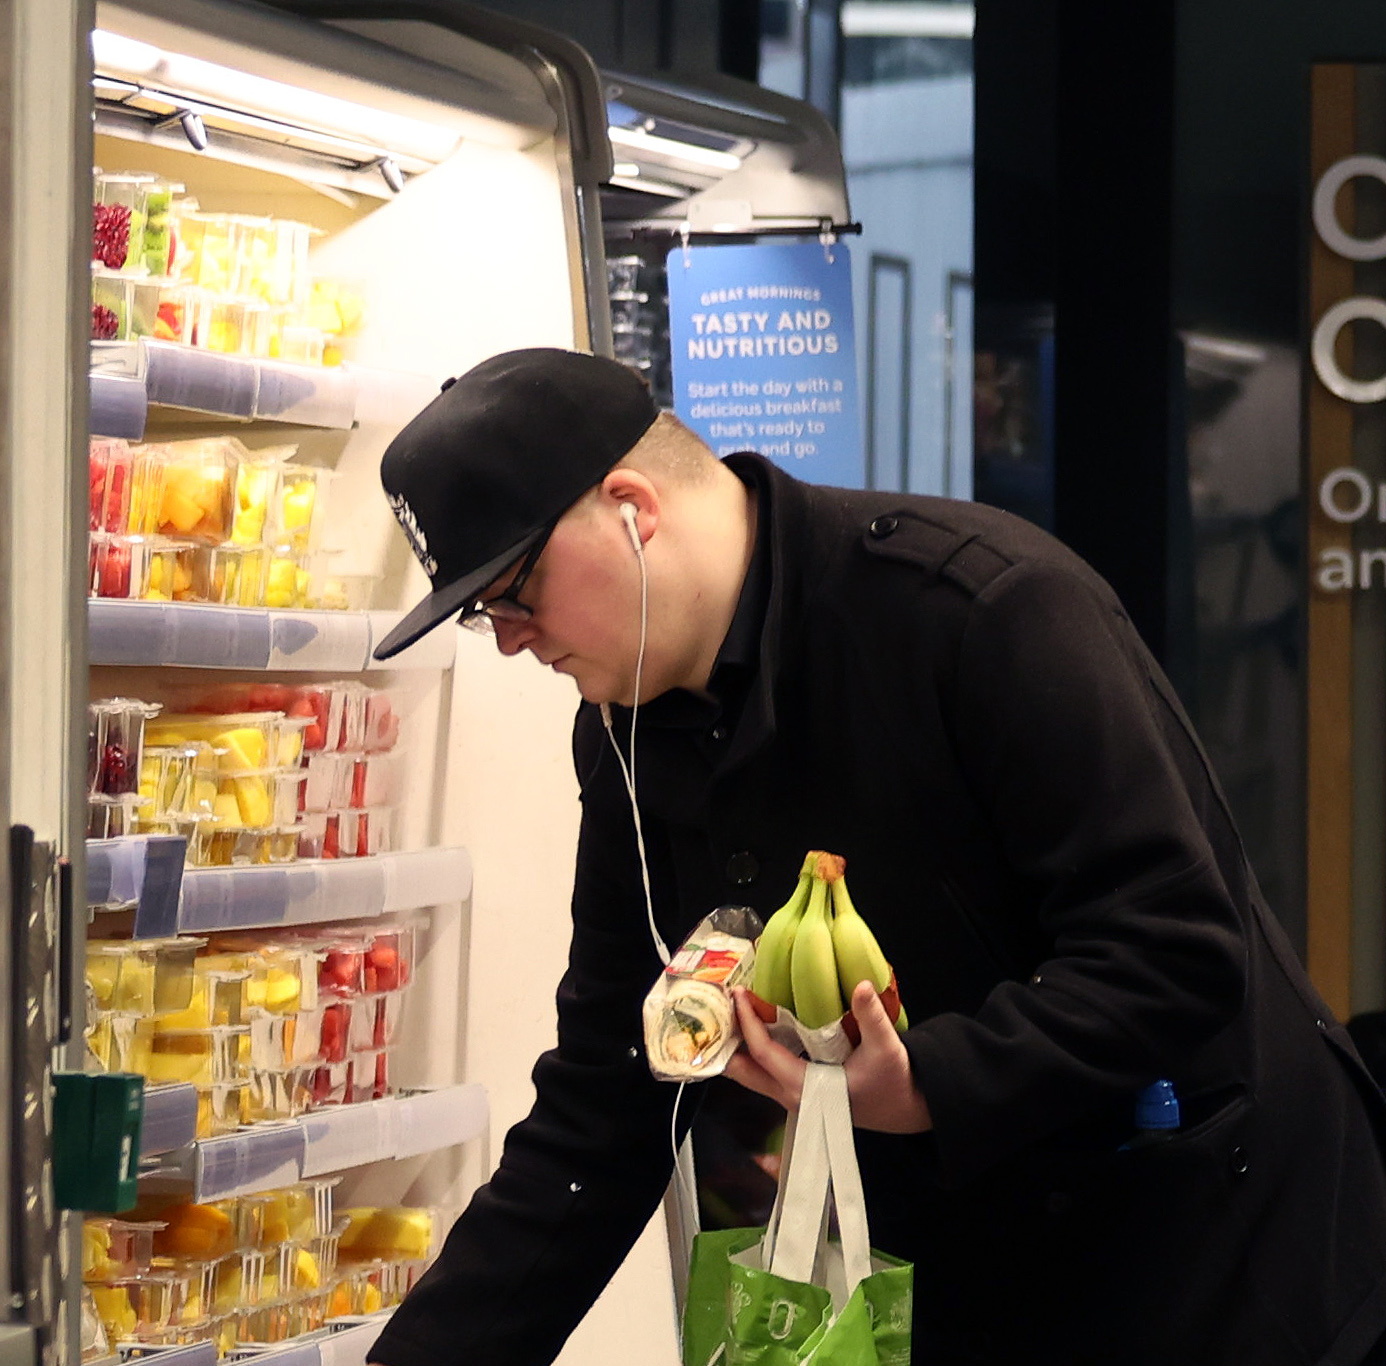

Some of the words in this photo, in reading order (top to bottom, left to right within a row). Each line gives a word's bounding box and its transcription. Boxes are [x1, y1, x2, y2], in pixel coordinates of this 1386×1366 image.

[701, 287, 744, 307] GREAT
[747, 285, 822, 302] MORNINGS
[691, 311, 769, 334] TASTY
[777, 309, 832, 332] AND
[688, 334, 839, 360] NUTRITIOUS
[688, 381, 729, 399] Start
[732, 380, 758, 397] the
[762, 379, 792, 398] day
[796, 377, 829, 394] with
[833, 380, 843, 393] a
[691, 403, 762, 419] delicious
[766, 398, 842, 416] breakfast
[710, 421, 755, 438] that's
[759, 420, 804, 437] ready
[808, 420, 825, 435] to
[759, 441, 790, 456] and
